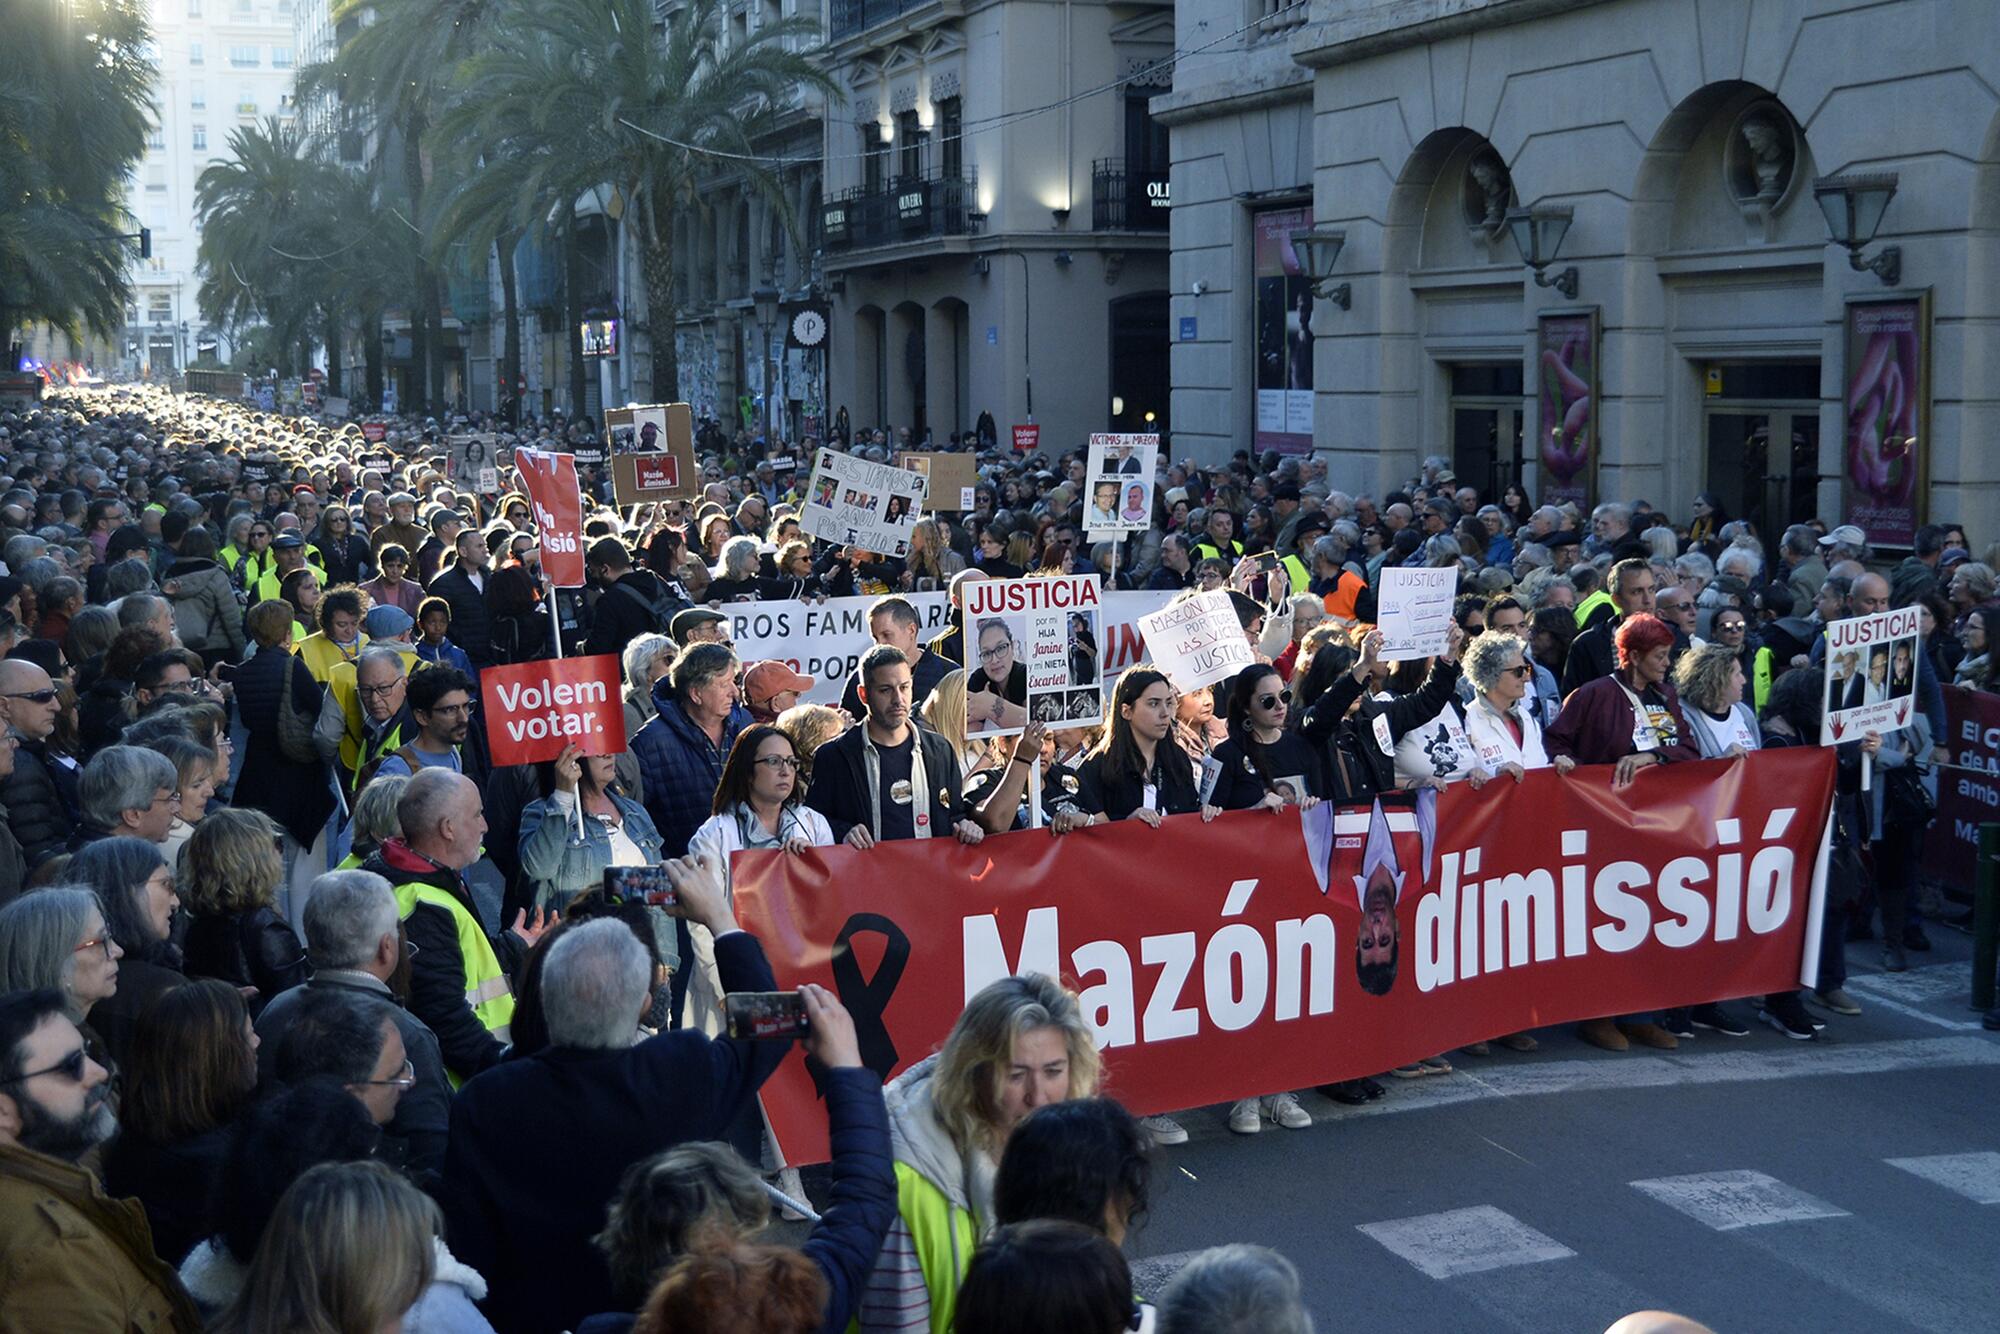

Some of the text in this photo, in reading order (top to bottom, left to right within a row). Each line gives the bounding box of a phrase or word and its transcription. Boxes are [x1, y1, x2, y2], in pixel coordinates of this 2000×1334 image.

[643, 471, 664, 480] Mazón
[836, 456, 913, 493] ESTAMOS
[1399, 572, 1446, 588] JUSTICIA
[970, 579, 1098, 615] JUSTICIA
[1035, 617, 1047, 628] por
[1150, 598, 1204, 634] MAZON
[1186, 619, 1209, 636] POR
[1038, 629, 1056, 639] HIJA
[1832, 611, 1917, 648] JUSTICIA
[1032, 642, 1063, 658] Janine
[1176, 637, 1203, 655] LAS
[808, 655, 860, 681] POR
[1044, 659, 1067, 670] NIETA
[1028, 673, 1067, 688] Escarlett
[496, 678, 607, 713] Volem
[506, 711, 604, 743] votar.
[1961, 719, 1978, 743] El
[1959, 749, 1983, 770] de
[1957, 778, 1998, 807] amb
[1414, 808, 1797, 993] dimissió
[962, 878, 1336, 1050] Mazón
